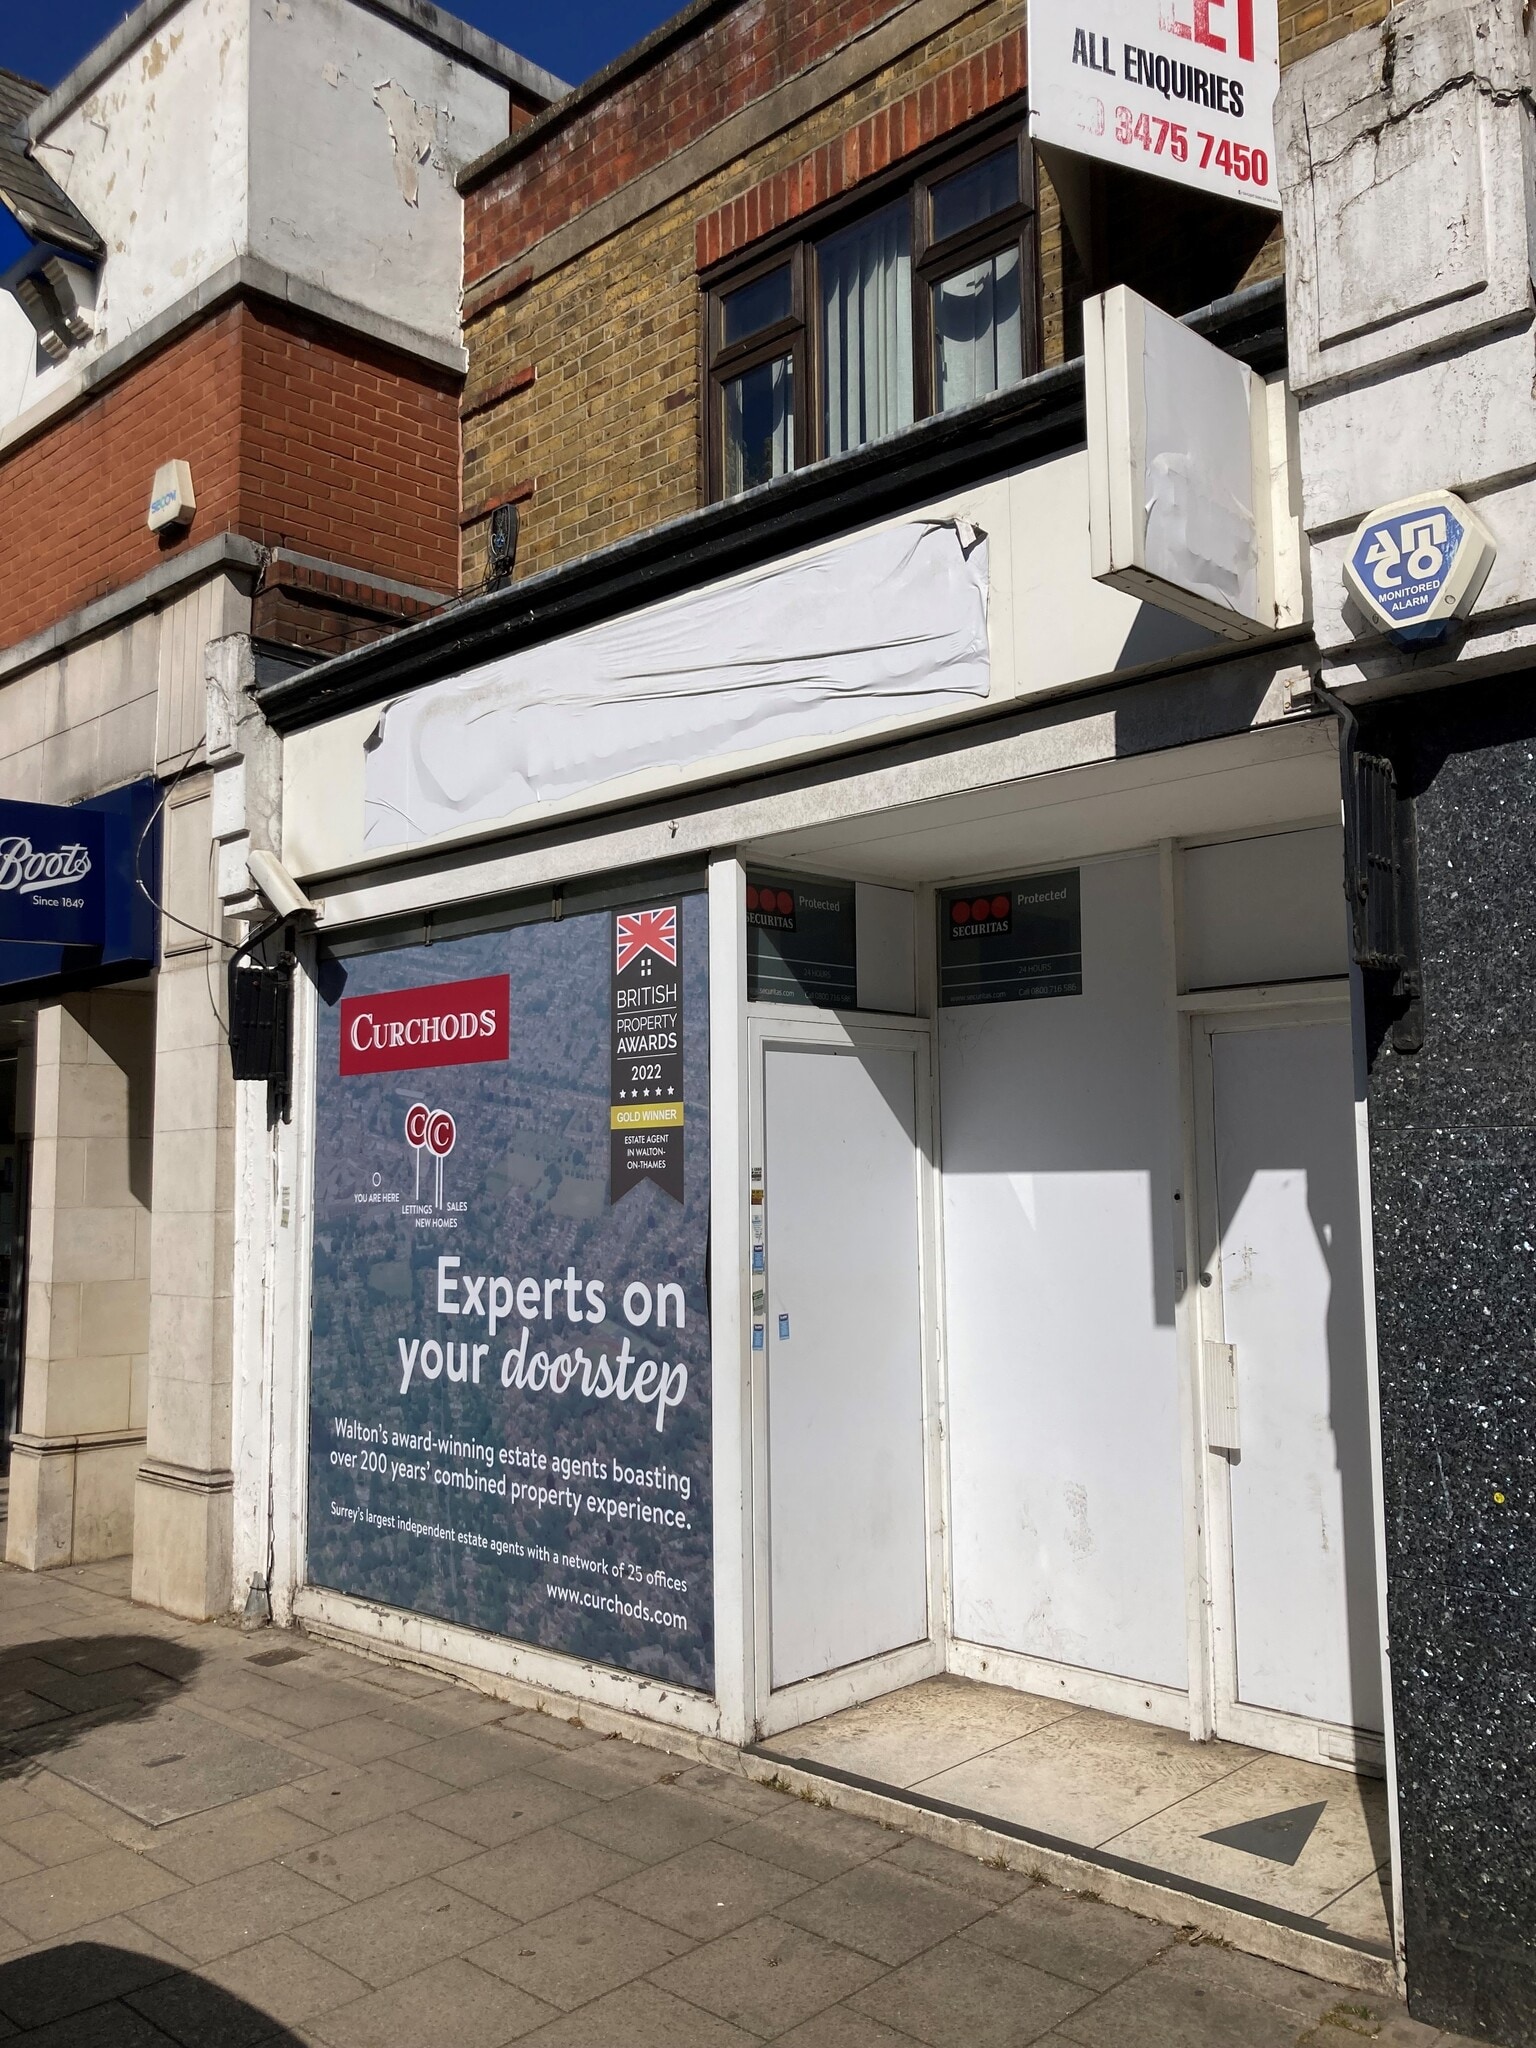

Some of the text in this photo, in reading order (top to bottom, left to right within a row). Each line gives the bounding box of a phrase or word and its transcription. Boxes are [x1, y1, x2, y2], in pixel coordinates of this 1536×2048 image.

[1071, 27, 1116, 76] ALL
[1123, 43, 1245, 118] ENQUIRIES
[1115, 105, 1189, 163] 3475
[1196, 131, 1269, 187] 7450
[1378, 579, 1441, 603] MONITORED
[1391, 595, 1429, 612] ALARM
[0, 836, 92, 894] Boots
[32, 895, 85, 909] Since 1849
[799, 895, 840, 912] Protected
[1017, 888, 1067, 905] Protected
[952, 921, 1009, 937] SECURITAS
[1027, 963, 1052, 973] HOURS
[616, 983, 677, 1009] BRITISH
[1030, 987, 1048, 997] 0800
[350, 1009, 497, 1052] CURCHODS
[616, 1012, 678, 1034] PROPERTY
[616, 1032, 678, 1054] AWARDS
[631, 1063, 662, 1081] 2022
[616, 1109, 677, 1123] GOLD WINNER
[624, 1134, 669, 1145] ESTATE AGENT
[626, 1147, 666, 1157] IN WALTON-
[626, 1159, 667, 1170] ON-THAMES
[353, 1192, 400, 1203] YOU ARE HERE
[401, 1204, 433, 1215] LETTINGS
[446, 1201, 468, 1212] SALES
[415, 1217, 458, 1228] NEW HOMES
[437, 1255, 686, 1337] Experts on
[398, 1326, 688, 1433] your doorstep
[334, 1416, 691, 1500] Walton's award-winning estate agents boasting
[330, 1450, 692, 1530] over 200 years' combined property experience.
[330, 1500, 688, 1592] Surrey's largest independent estate agents with a network of 25 offices
[546, 1583, 688, 1631] www.curchods.com
